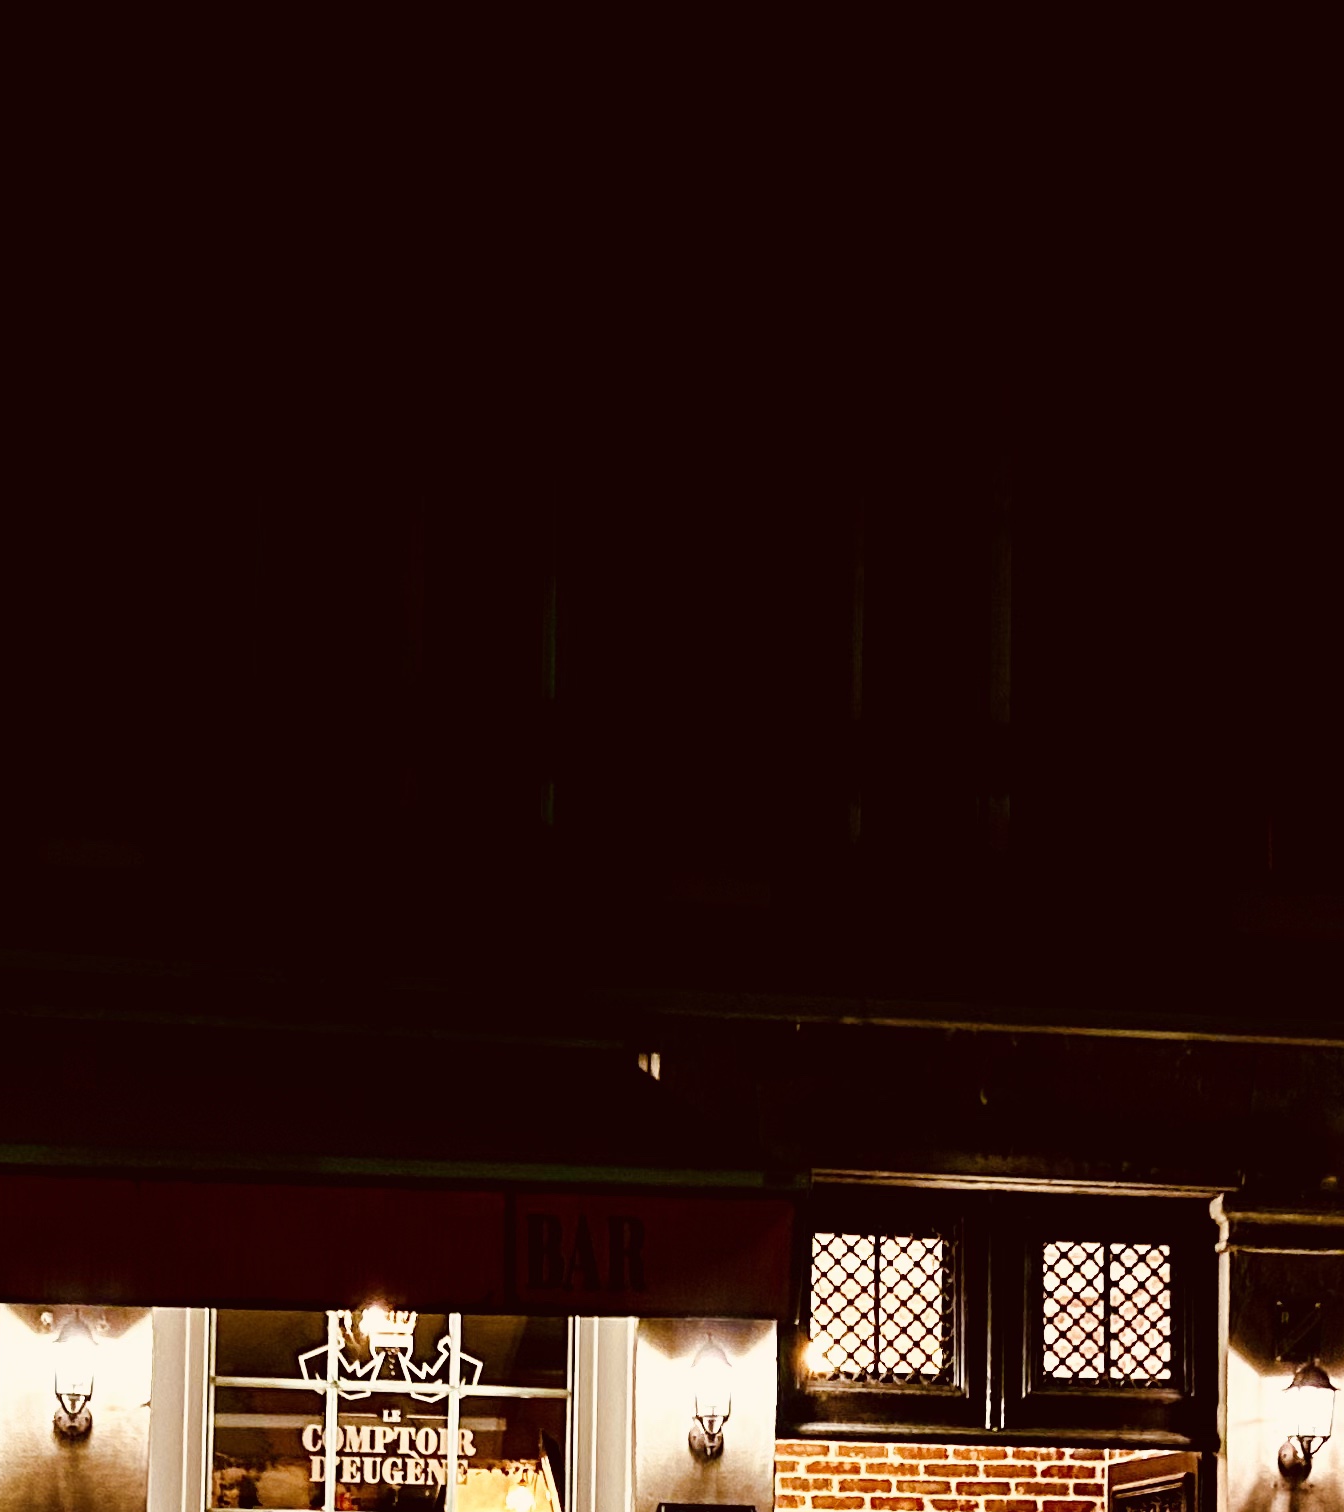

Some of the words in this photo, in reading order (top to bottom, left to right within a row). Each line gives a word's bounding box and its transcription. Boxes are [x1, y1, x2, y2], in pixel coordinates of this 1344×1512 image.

[523, 1213, 644, 1291] BAR
[382, 1409, 402, 1423] LE
[301, 1423, 477, 1457] COMPTOIR
